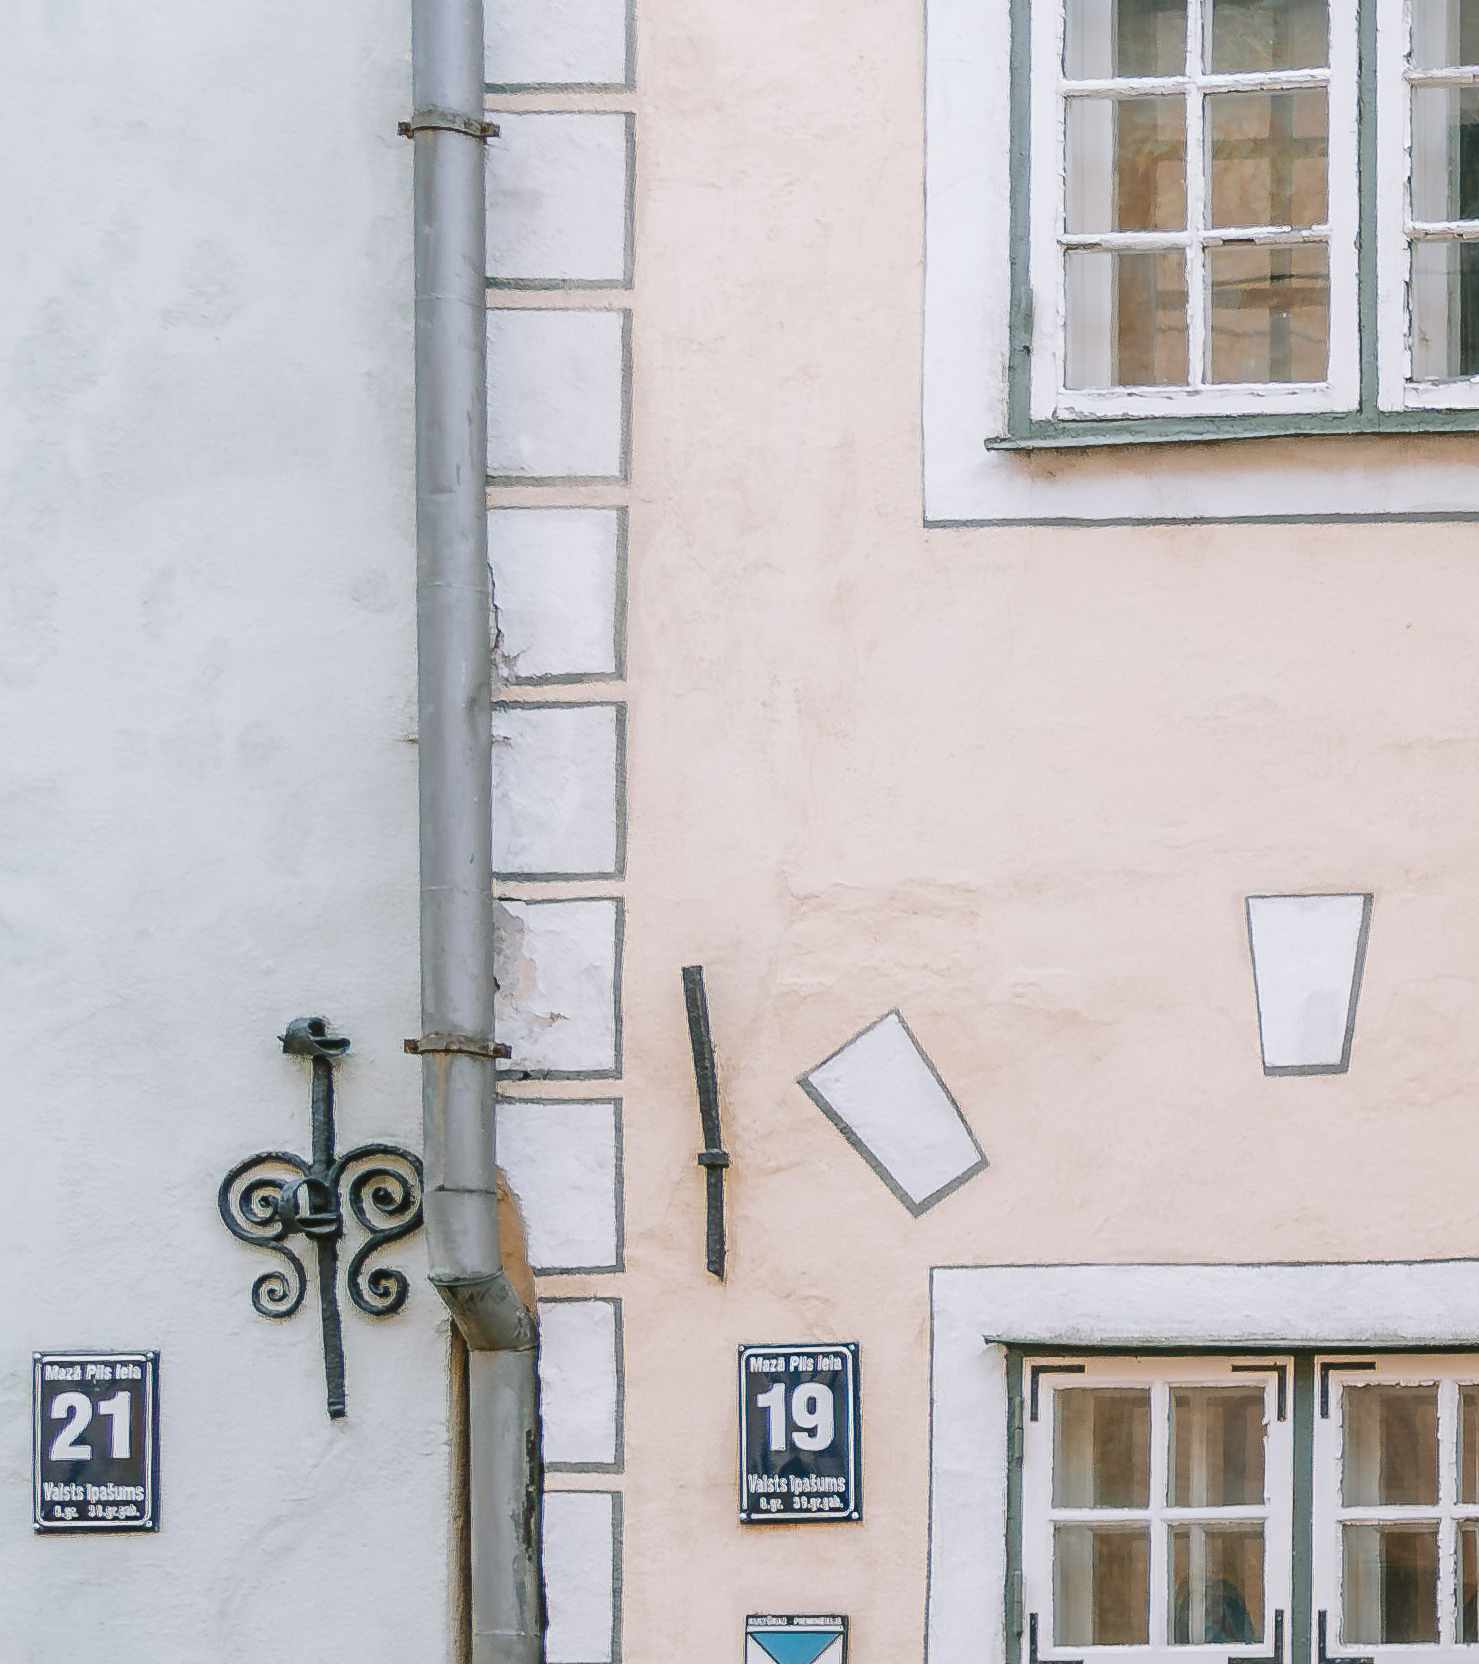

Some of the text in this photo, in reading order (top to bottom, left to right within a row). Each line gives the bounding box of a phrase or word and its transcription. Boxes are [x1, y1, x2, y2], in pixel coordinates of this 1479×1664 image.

[45, 1363, 142, 1381] Mazā Pils iela
[750, 1354, 842, 1373] Mazā Pils iela
[49, 1391, 131, 1461] 21
[756, 1382, 835, 1452] 19
[43, 1482, 84, 1501] Valsts
[747, 1473, 788, 1493] Valsts
